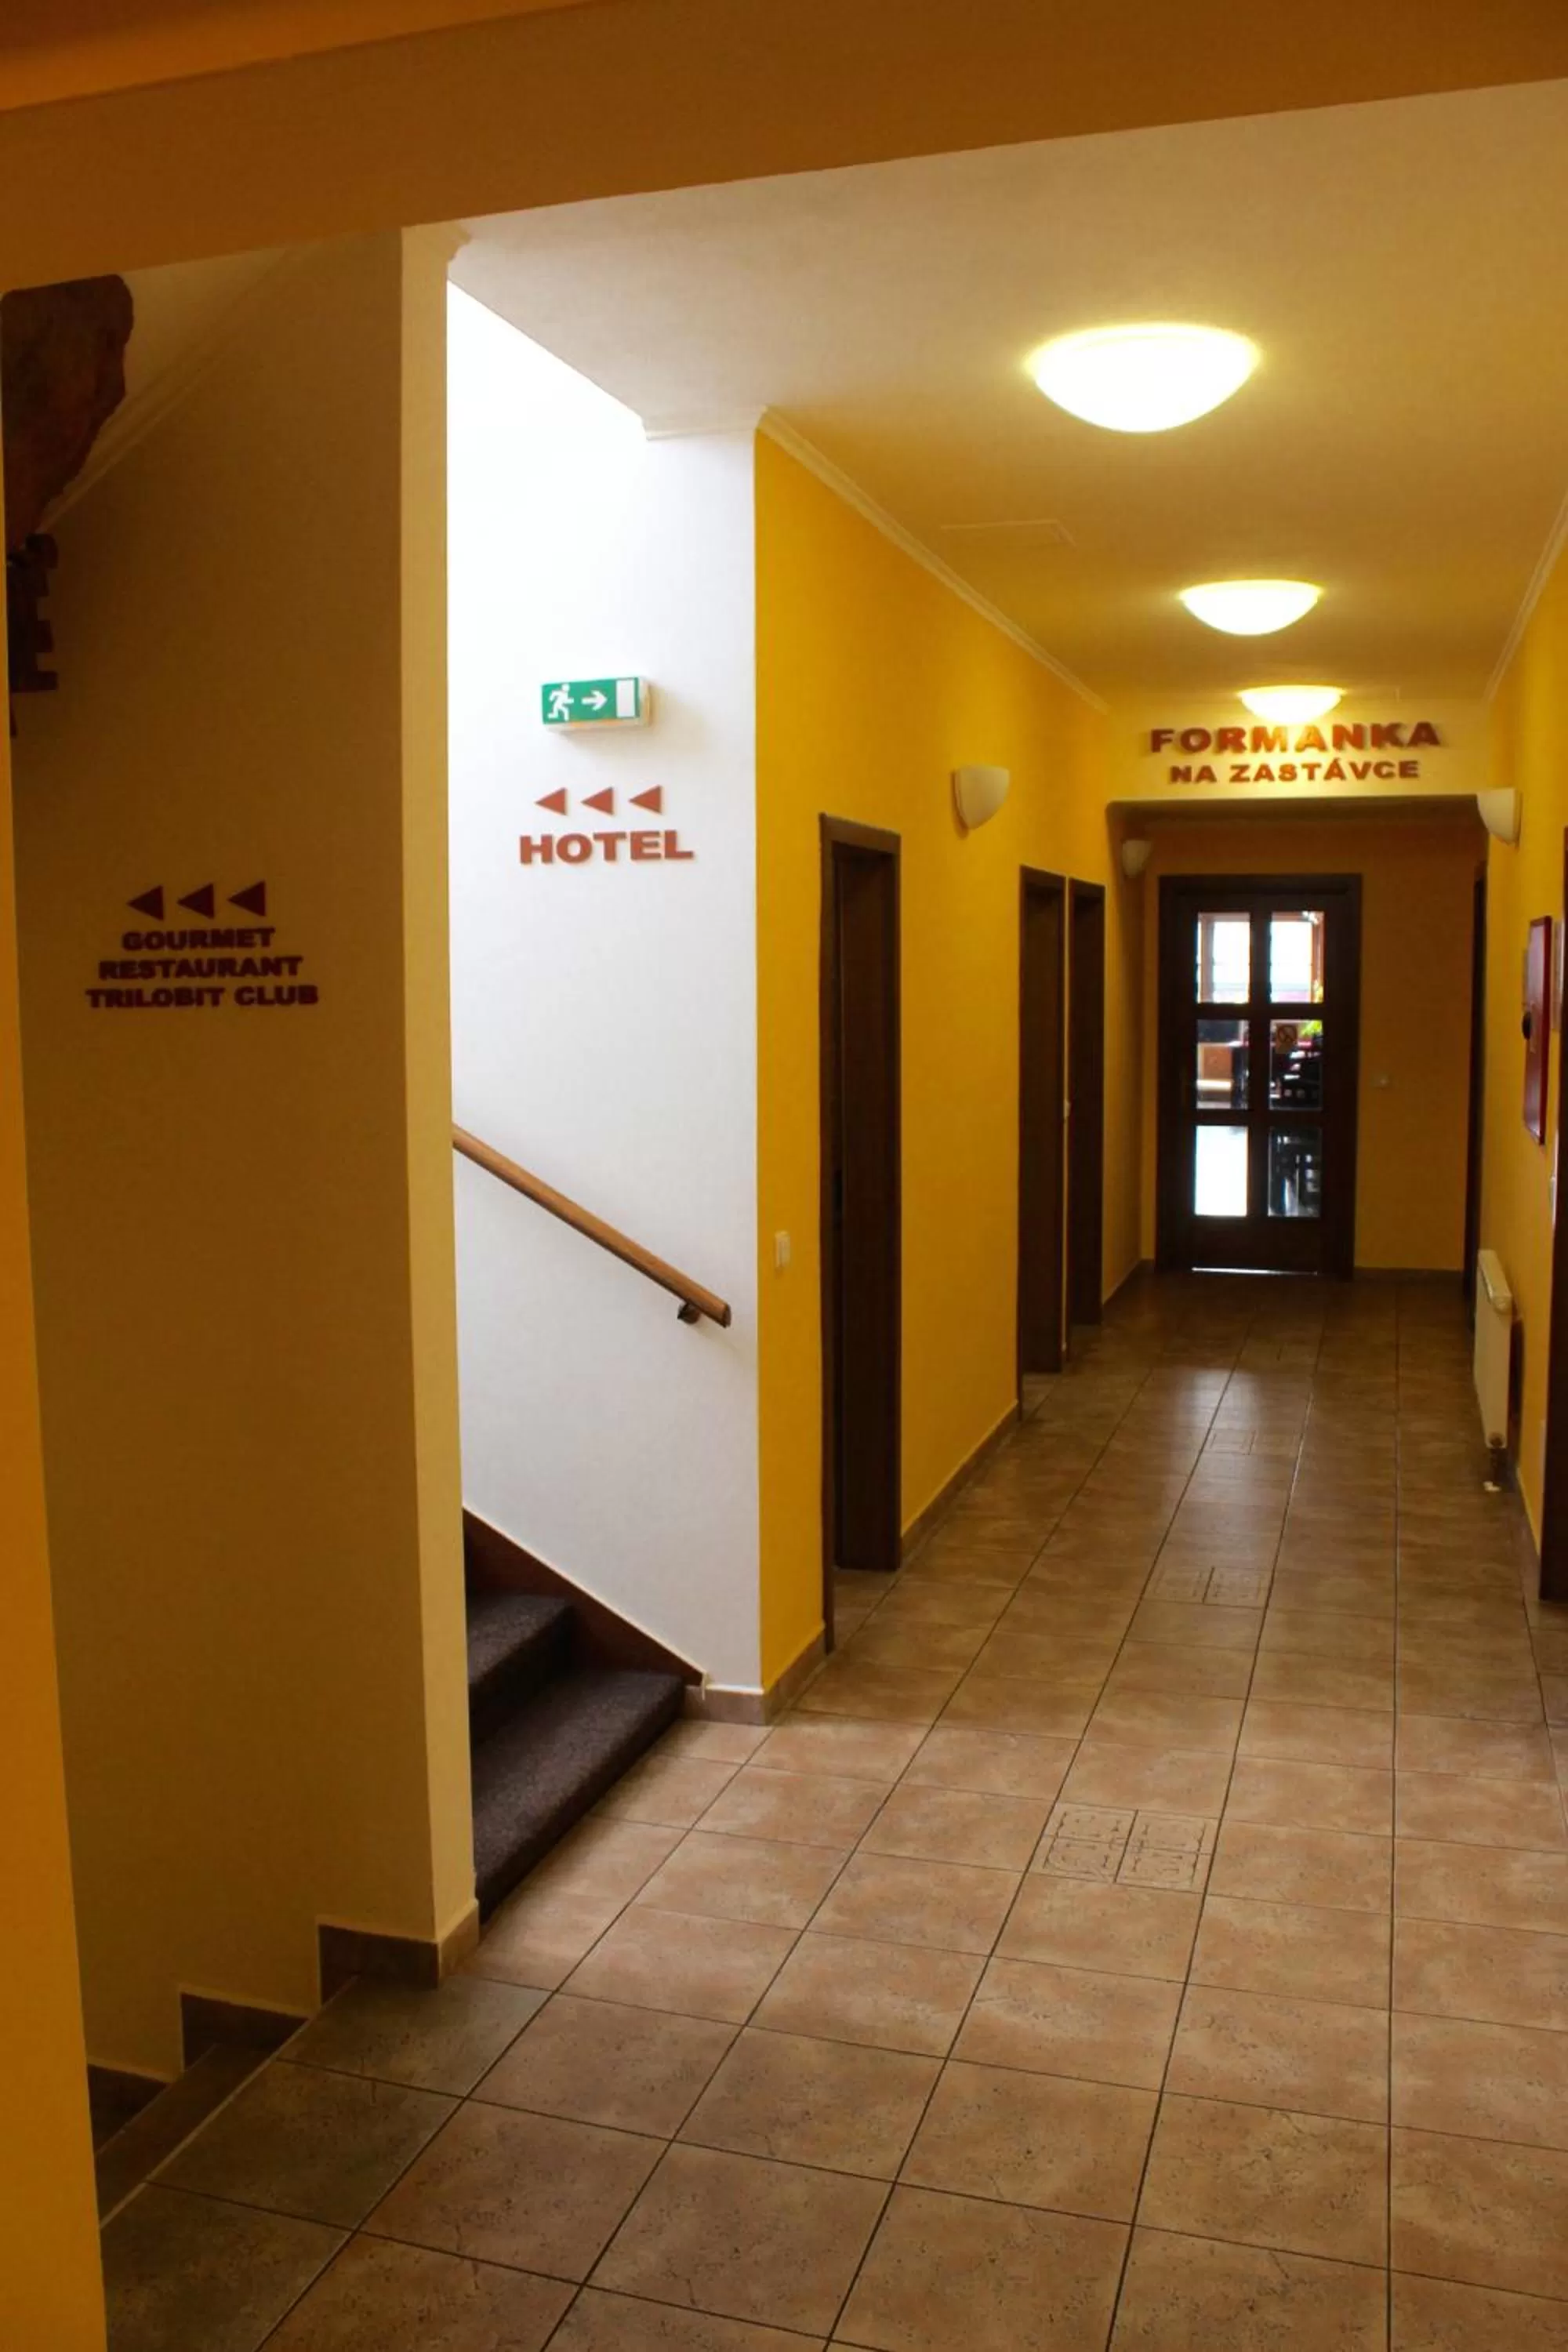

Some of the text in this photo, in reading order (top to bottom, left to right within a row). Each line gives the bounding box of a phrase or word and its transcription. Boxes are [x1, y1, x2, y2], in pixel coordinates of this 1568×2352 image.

[1150, 721, 1440, 753] FORMANKA
[1171, 758, 1420, 783] NA ZASTÁVCE
[520, 829, 694, 865] HOTEL
[122, 927, 275, 951] GOURMET
[99, 956, 303, 980] RESTAURANT
[85, 985, 318, 1008] TRILOBIT CLUB
